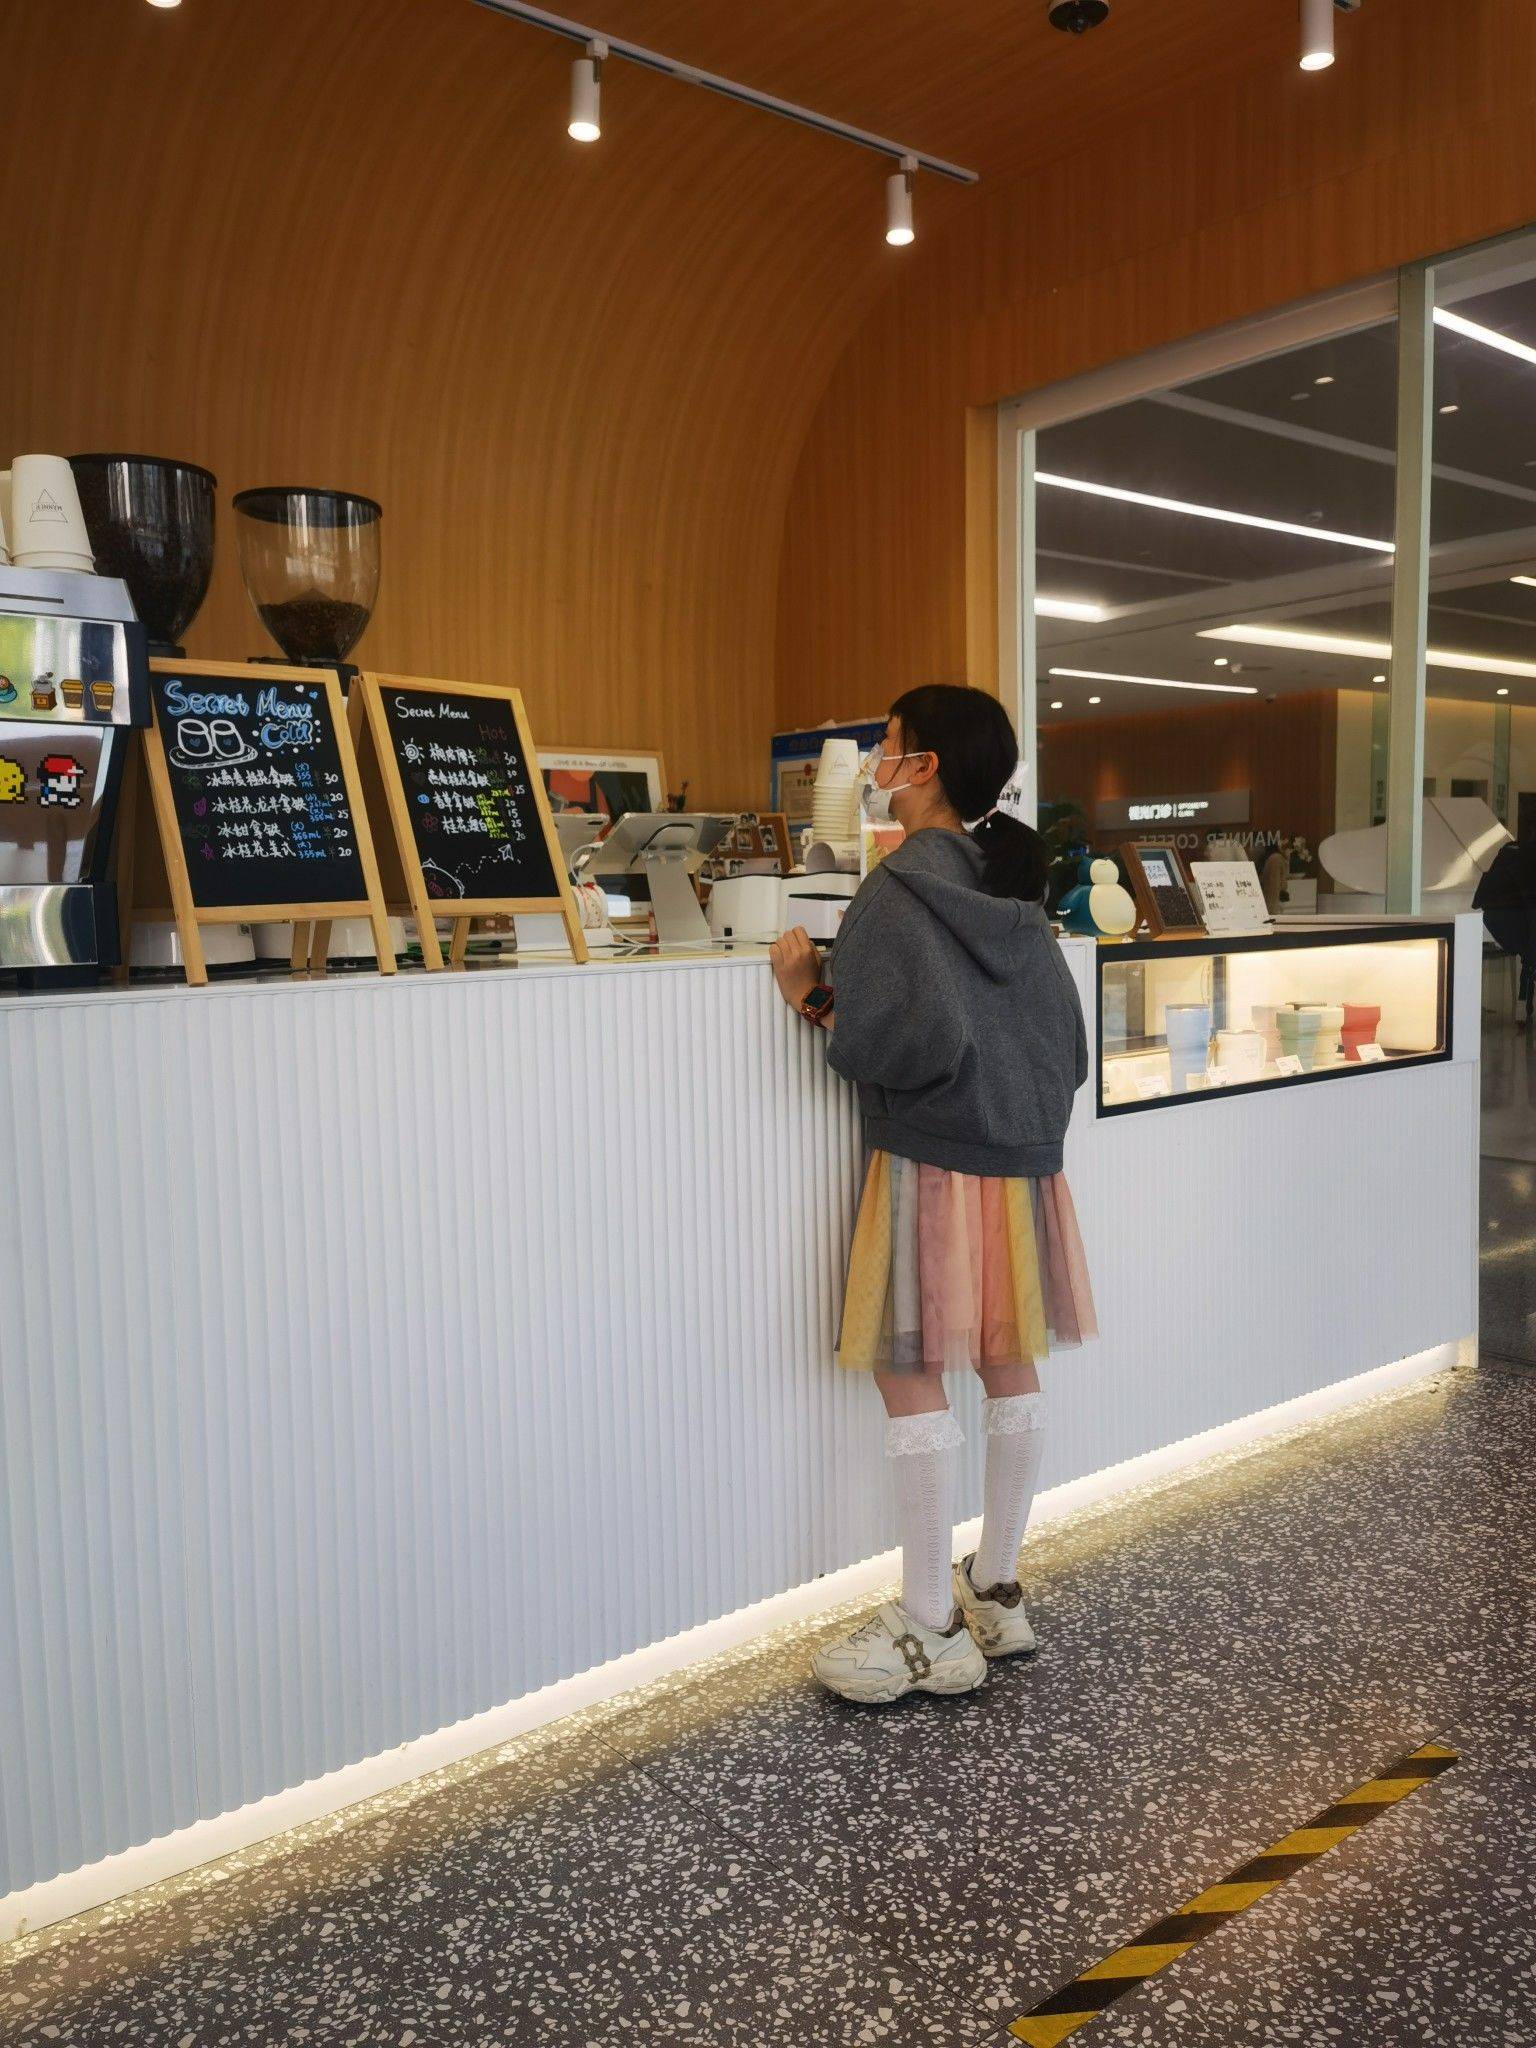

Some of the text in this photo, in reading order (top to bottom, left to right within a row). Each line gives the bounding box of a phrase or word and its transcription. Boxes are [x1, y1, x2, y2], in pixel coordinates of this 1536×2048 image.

[164, 680, 313, 719] Secret Menu
[395, 696, 470, 720] Secret Menu
[261, 720, 311, 749] Cold
[504, 752, 517, 765] 30
[324, 772, 339, 785] 30
[330, 793, 344, 802] 20
[333, 827, 348, 839] 20
[338, 846, 352, 857] 20
